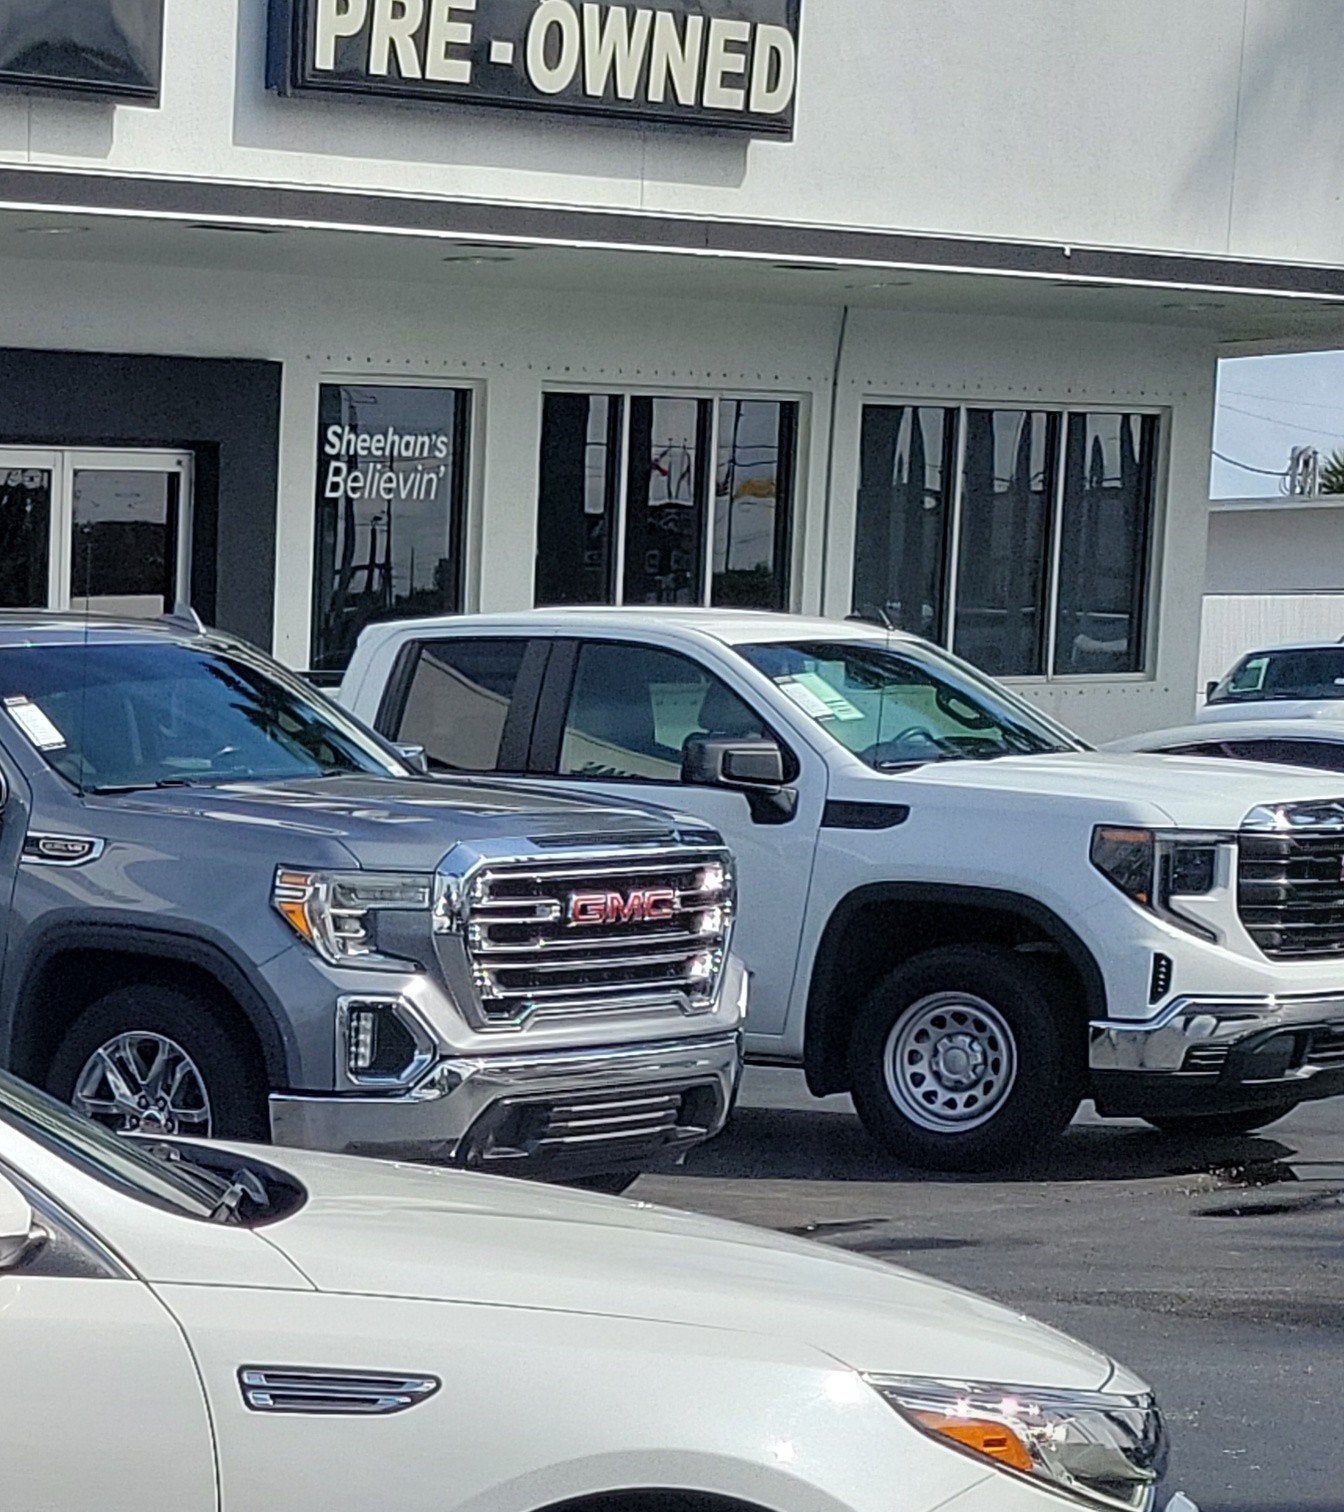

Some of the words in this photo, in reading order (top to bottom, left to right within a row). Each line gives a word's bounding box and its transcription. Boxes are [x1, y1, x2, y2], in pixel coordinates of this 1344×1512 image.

[324, 425, 448, 458] Sheehan's
[324, 460, 445, 500] Believin'
[571, 889, 673, 924] GMC
